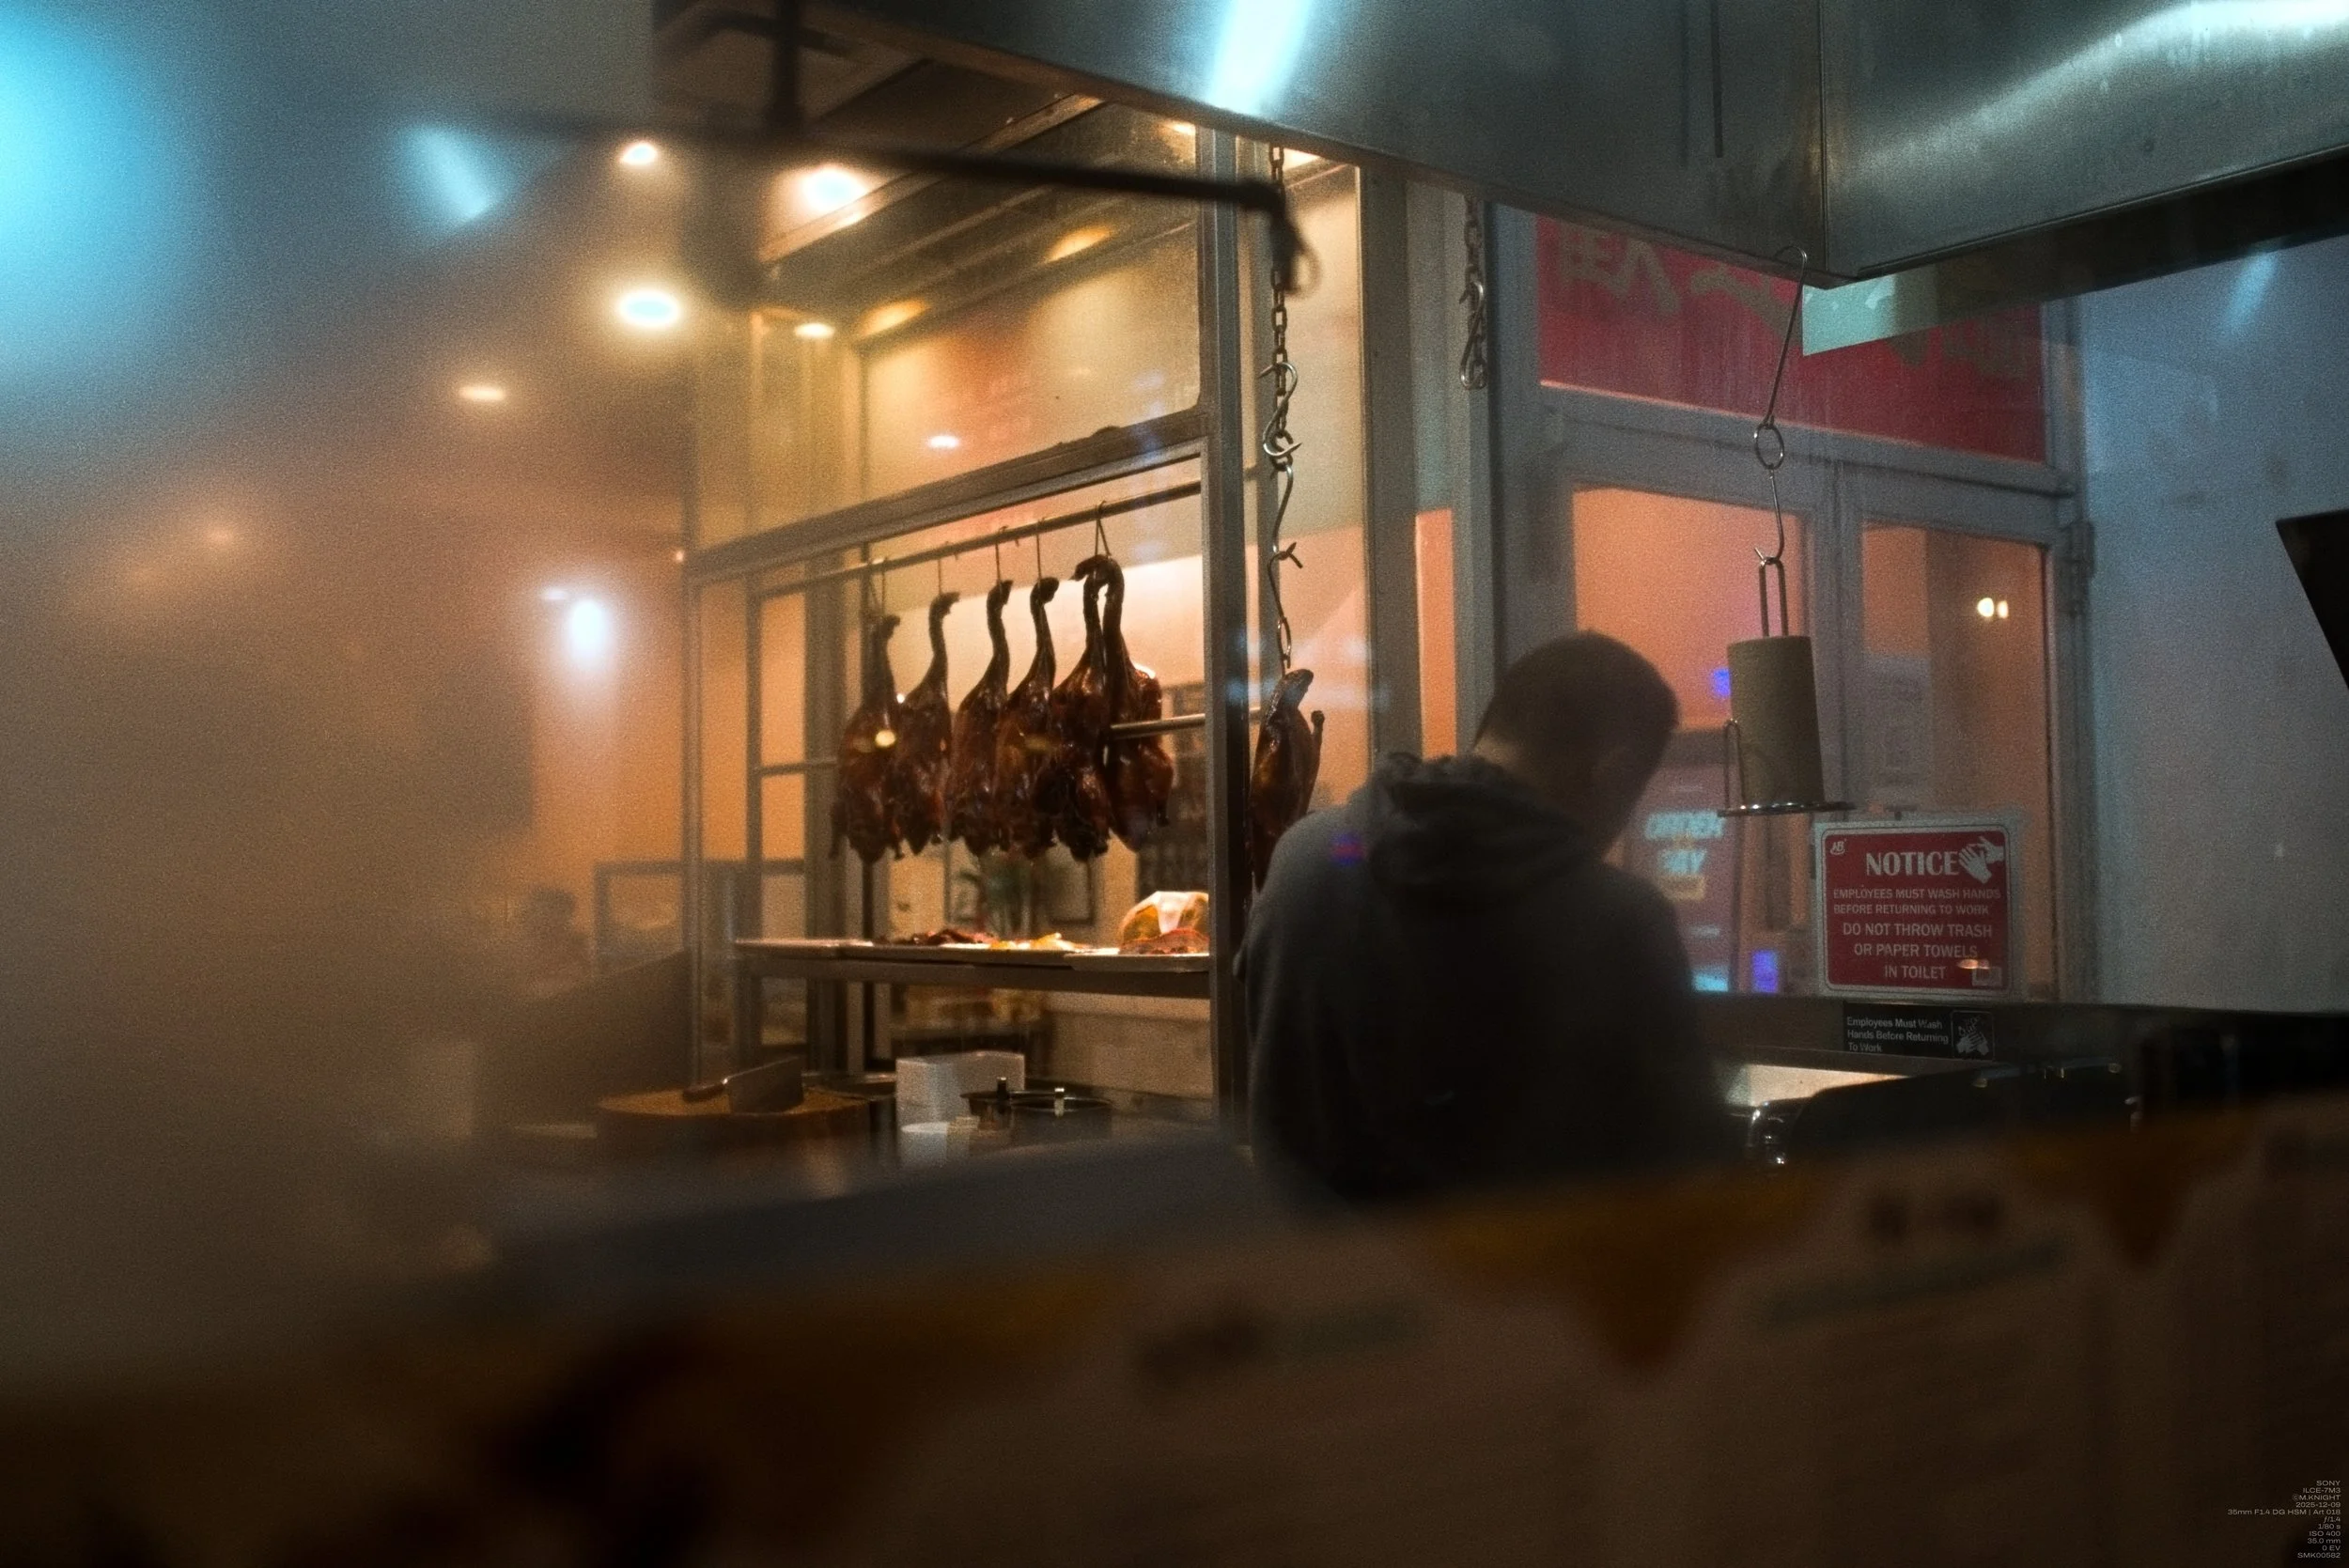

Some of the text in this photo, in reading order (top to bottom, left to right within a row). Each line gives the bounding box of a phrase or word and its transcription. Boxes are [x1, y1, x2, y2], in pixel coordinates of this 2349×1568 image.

[1866, 851, 1959, 876] NOTICE
[1833, 889, 2001, 899] EMPLOYEES MUST WASH HANDS
[1834, 905, 1988, 915] BEFORE RETURNING TO WORK
[1843, 923, 1992, 938] DO NOT THROW TRASH
[1854, 943, 1978, 958] OR PAPER TOWELS
[1885, 965, 1946, 979] IN TOILET
[1846, 1017, 1942, 1030] Employees Must Wash
[1847, 1030, 1949, 1044] Hands Before Returning
[1848, 1042, 1882, 1052] To Work
